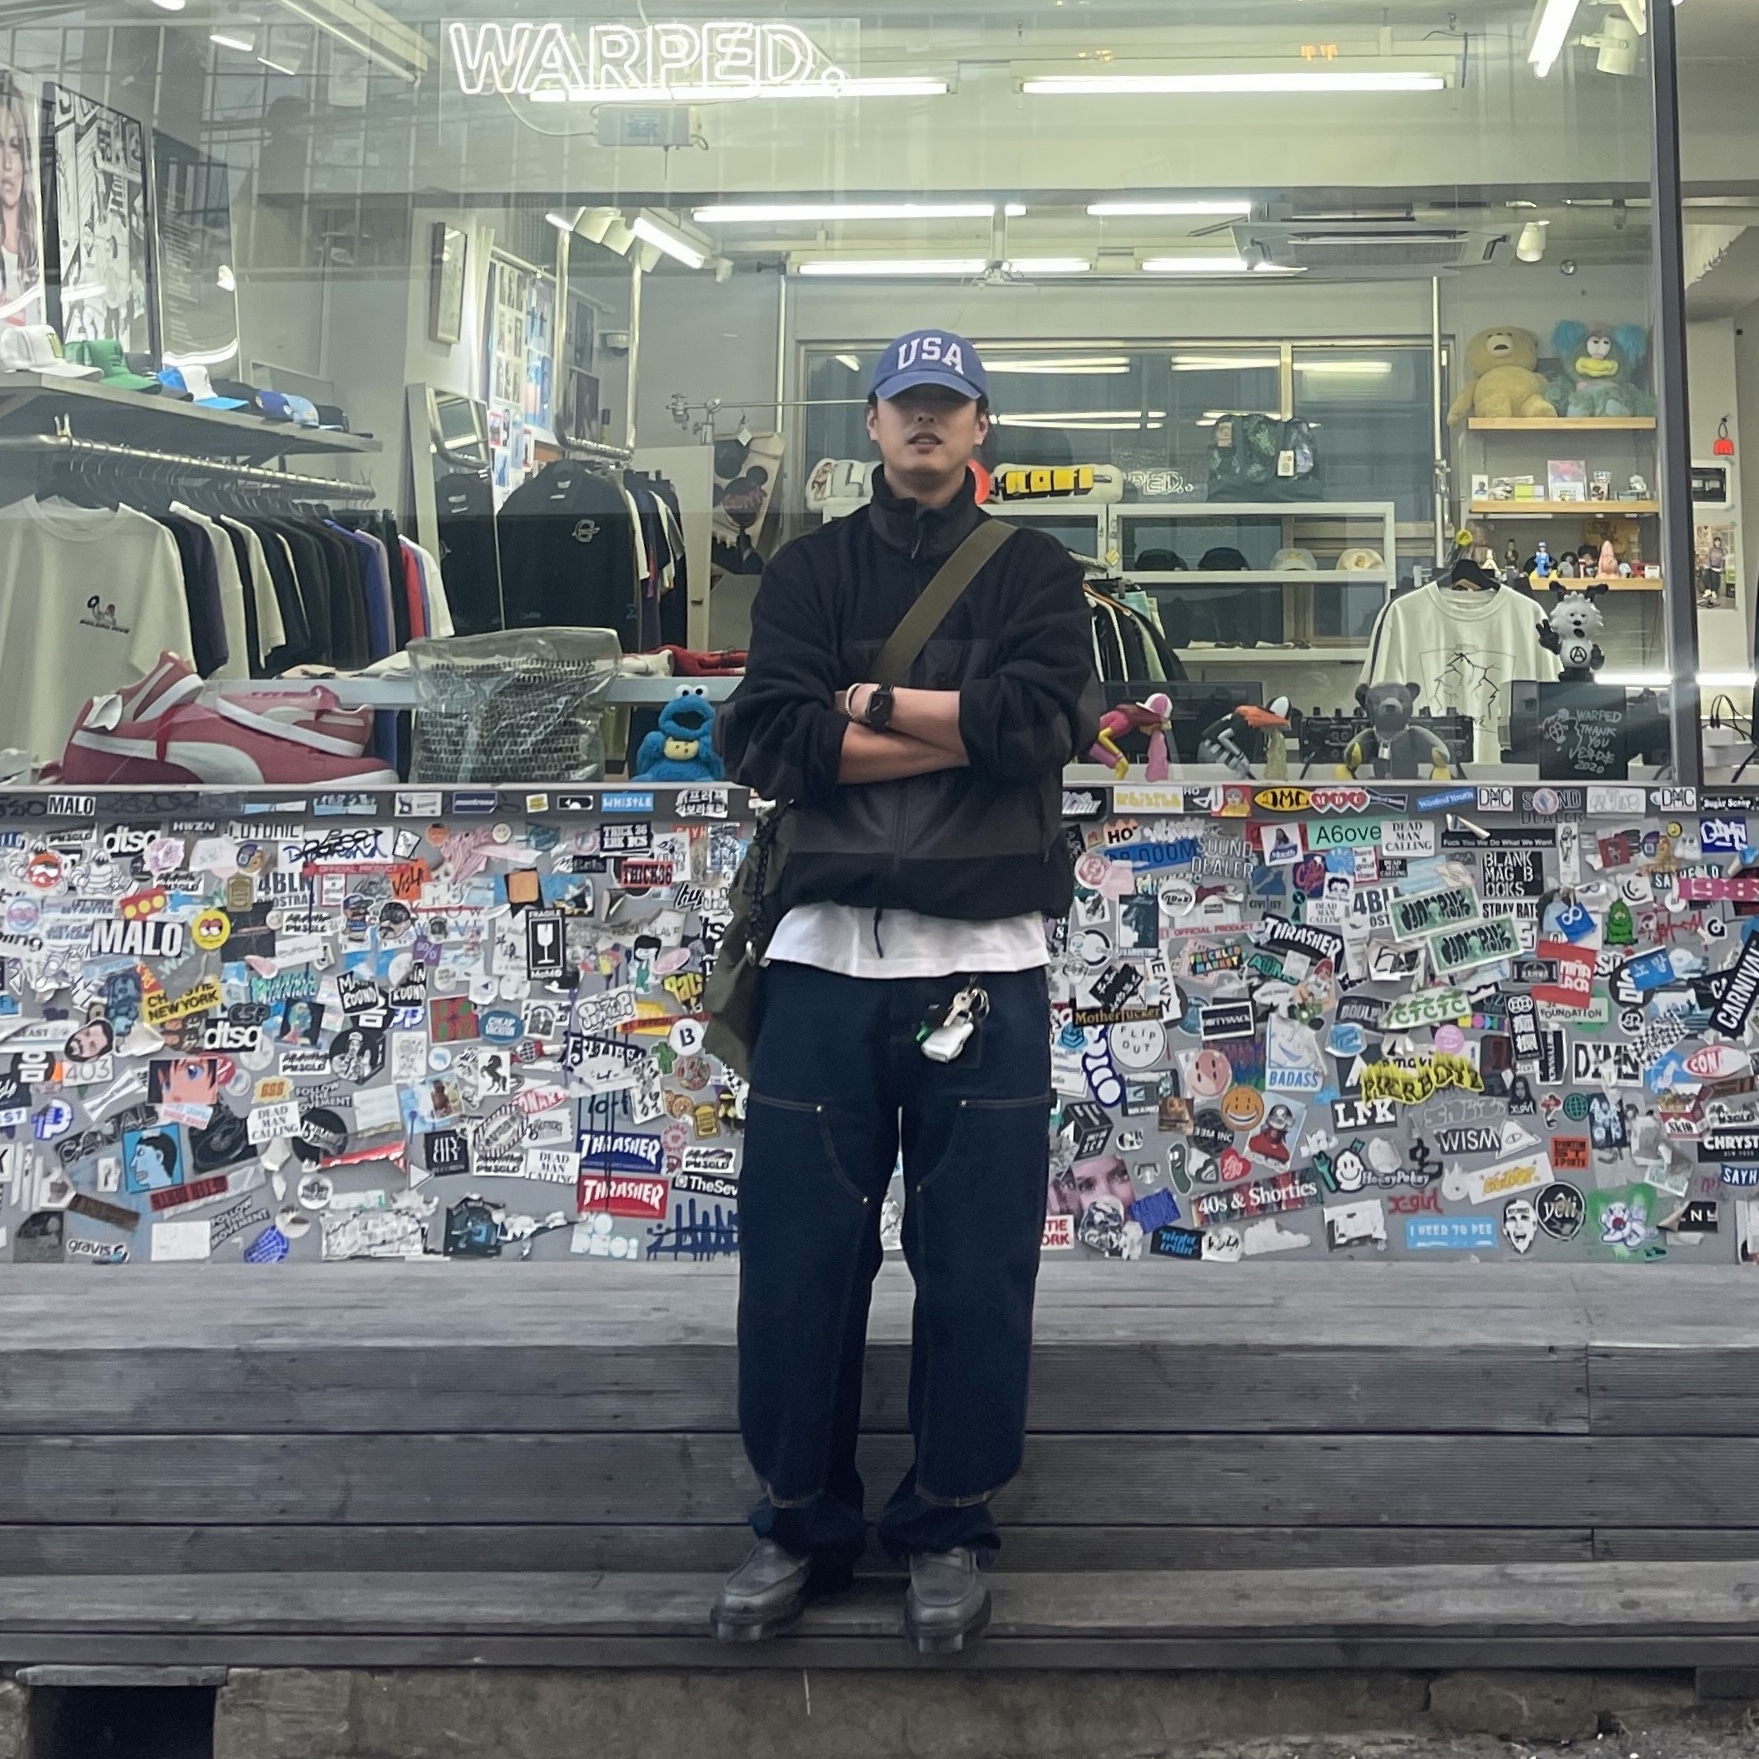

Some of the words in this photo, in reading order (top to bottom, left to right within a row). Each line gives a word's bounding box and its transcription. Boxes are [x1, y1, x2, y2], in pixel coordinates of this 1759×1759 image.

[898, 337, 964, 375] USA
[1577, 709, 1622, 723] WARPED
[1580, 724, 1617, 738] THANK
[1588, 736, 1610, 749] YOU
[1575, 760, 1605, 774] 2020
[1478, 787, 1512, 807] DMC
[1522, 789, 1581, 811] SND
[1661, 788, 1695, 808] DMC
[49, 796, 94, 815] MALO
[173, 821, 216, 831] HWZN
[1393, 822, 1423, 833] DEAD
[1395, 831, 1421, 841] MAN
[1443, 839, 1461, 847] Fuck
[1197, 837, 1254, 858] SOUND
[1385, 840, 1432, 852] CALLING
[1191, 855, 1254, 879] DEALER
[1484, 852, 1533, 867] BLANK
[1484, 866, 1514, 883] MAG
[1523, 866, 1534, 881] B
[1484, 881, 1525, 897] OOKS
[529, 909, 562, 918] FRAGILE
[1315, 902, 1338, 911] DEAD
[1318, 909, 1338, 918] MAN
[1482, 902, 1514, 919] STRAY
[1174, 925, 1211, 936] OFFICIAL
[1214, 922, 1254, 934] PRODUCT
[91, 919, 184, 958] MALO
[1264, 917, 1343, 958] THRASHER
[149, 1002, 182, 1021] NEW
[181, 989, 219, 1010] YORK
[1540, 1007, 1602, 1018] FOUNDATION
[1120, 1025, 1155, 1042] FLIP
[1122, 1041, 1151, 1055] OUT
[65, 1059, 110, 1083] 403
[1268, 1069, 1319, 1088] BADASS
[295, 1082, 340, 1097] FOLLOW
[257, 1105, 289, 1119] DEAD
[299, 1097, 352, 1113] OVEMENT
[261, 1115, 287, 1128] MAN
[1335, 1099, 1396, 1129] LNK
[251, 1124, 300, 1140] CALLING
[580, 1133, 661, 1165] THRASHER
[1704, 1136, 1759, 1150] CHRYST
[539, 1152, 569, 1164] DEAD
[541, 1162, 565, 1173] MAN
[528, 1171, 576, 1184] CALLING
[582, 1178, 665, 1211] THRASHER
[1199, 1196, 1228, 1215] 40s
[1230, 1191, 1246, 1210] &
[1249, 1179, 1317, 1207] Shorties
[211, 1197, 253, 1226] FOLLOW
[211, 1210, 269, 1248] MOVEMENT
[1409, 1226, 1414, 1237] I
[1418, 1224, 1448, 1236] NEED
[1453, 1223, 1468, 1236] TO
[1471, 1223, 1493, 1235] PEE
[68, 1239, 112, 1256] gravis
